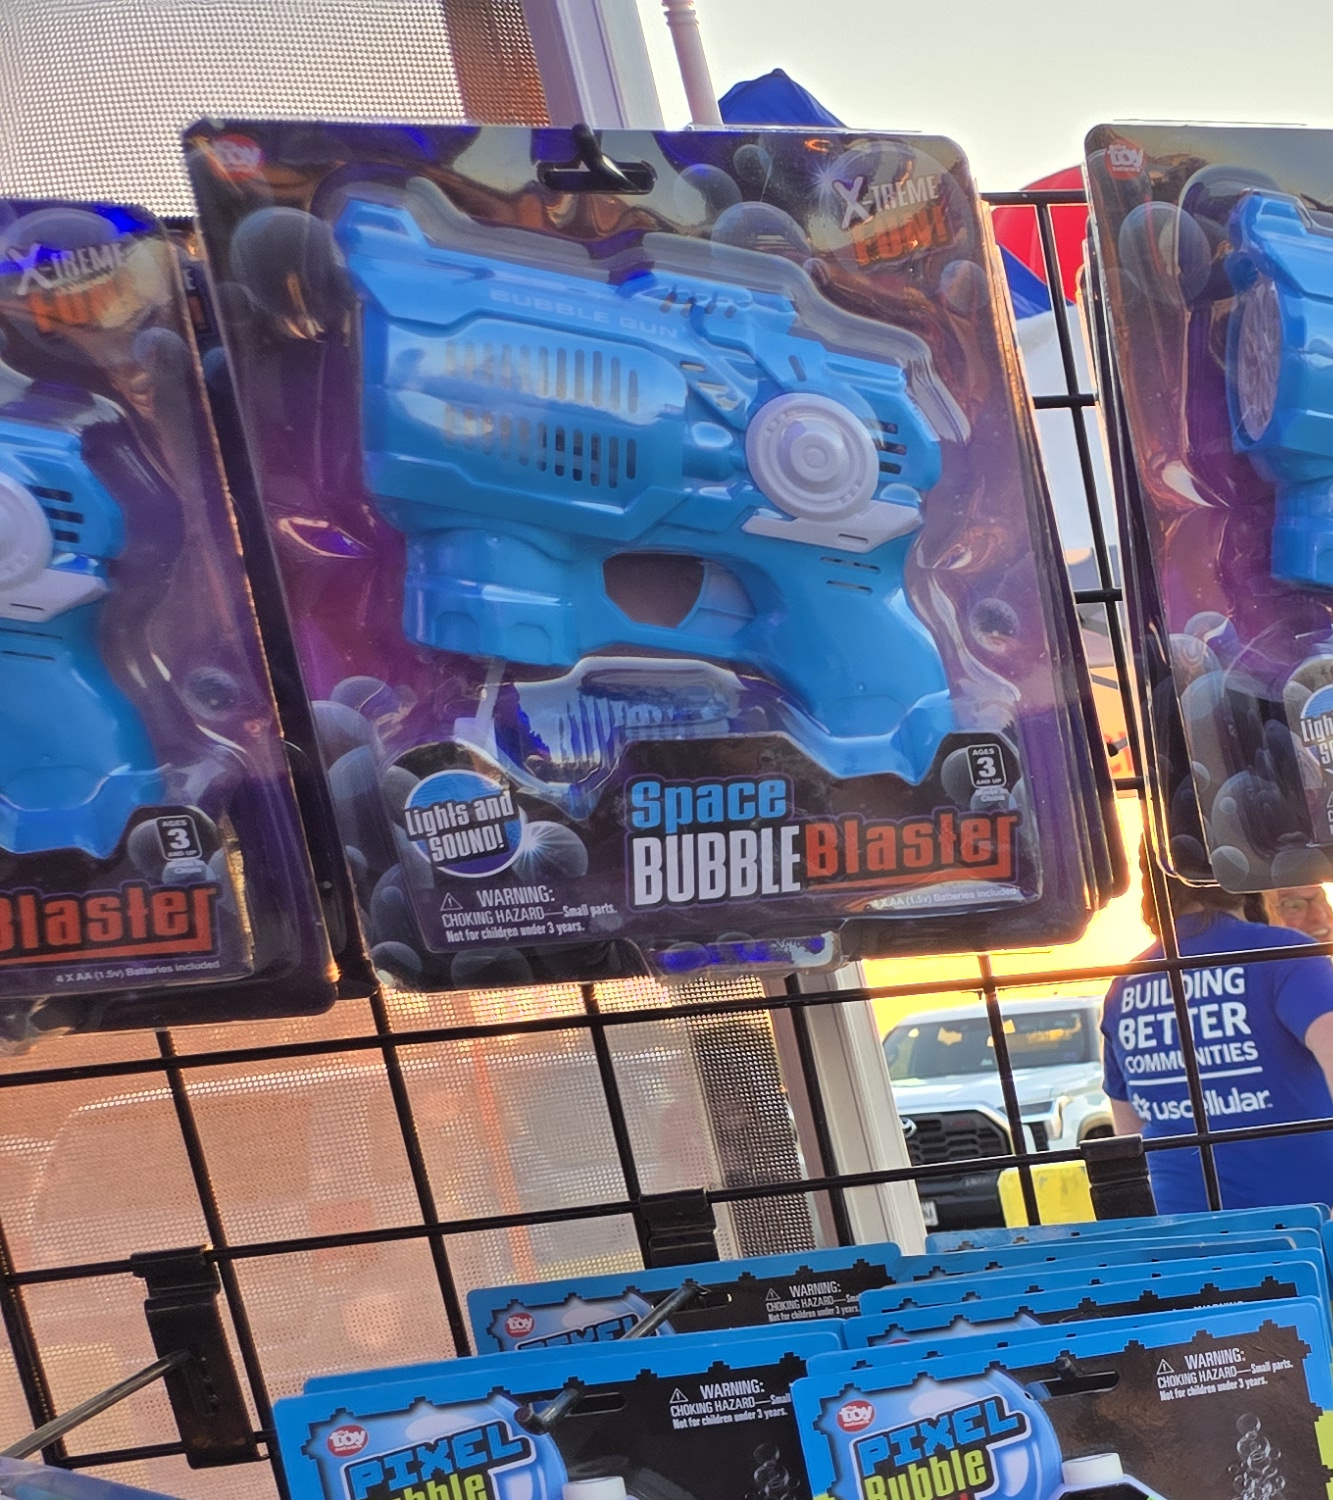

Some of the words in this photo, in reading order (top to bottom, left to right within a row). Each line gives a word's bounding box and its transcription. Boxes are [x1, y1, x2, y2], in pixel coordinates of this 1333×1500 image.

[1107, 149, 1143, 168] toy
[832, 174, 940, 229] X-TREME
[619, 317, 679, 339] GUN
[977, 757, 996, 777] 3
[404, 801, 469, 838] Lights
[474, 791, 514, 819] and
[631, 779, 787, 834] Space
[168, 828, 190, 849] 3
[429, 824, 504, 863] SOUND!
[476, 884, 555, 908] WARNING:
[934, 891, 974, 901] Batteries
[441, 910, 494, 928] CHOKING
[590, 903, 618, 918] parts.
[446, 931, 463, 942] Not
[464, 929, 480, 942] for
[481, 924, 518, 940] children
[520, 923, 546, 936] under
[548, 922, 554, 934] 3
[557, 921, 585, 935] years.
[77, 972, 93, 981] AA
[126, 965, 173, 976] Batteries
[1152, 1088, 1270, 1121] uscllular
[789, 1281, 841, 1298] WARNING:
[765, 1299, 800, 1313] CHOKING
[768, 1313, 780, 1322] Not
[780, 1312, 789, 1320] for
[791, 1309, 816, 1319] children
[817, 1308, 834, 1316] under
[835, 1306, 839, 1314] 3
[841, 1305, 860, 1315] years.
[506, 1316, 533, 1331] toy
[1184, 1347, 1246, 1370] WARNING:
[1157, 1372, 1197, 1389] CHOKING
[1272, 1359, 1293, 1373] parts.
[700, 1379, 765, 1399] WARNING:
[1160, 1390, 1174, 1401] Not
[1175, 1388, 1186, 1399] for
[1187, 1383, 1216, 1397] children
[1218, 1381, 1237, 1392] under
[1239, 1379, 1244, 1389] 3
[1245, 1377, 1268, 1390] years.
[670, 1402, 713, 1417] CHOKING
[673, 1418, 688, 1429] Not
[688, 1417, 700, 1427] for
[702, 1414, 733, 1426] children
[734, 1411, 756, 1422] under
[758, 1409, 762, 1418] 3
[764, 1408, 788, 1419] years.
[839, 1403, 874, 1422] toy
[329, 1430, 367, 1448] toy
[858, 1400, 1019, 1476] PIXEL
[349, 1425, 523, 1500] PIXEL
